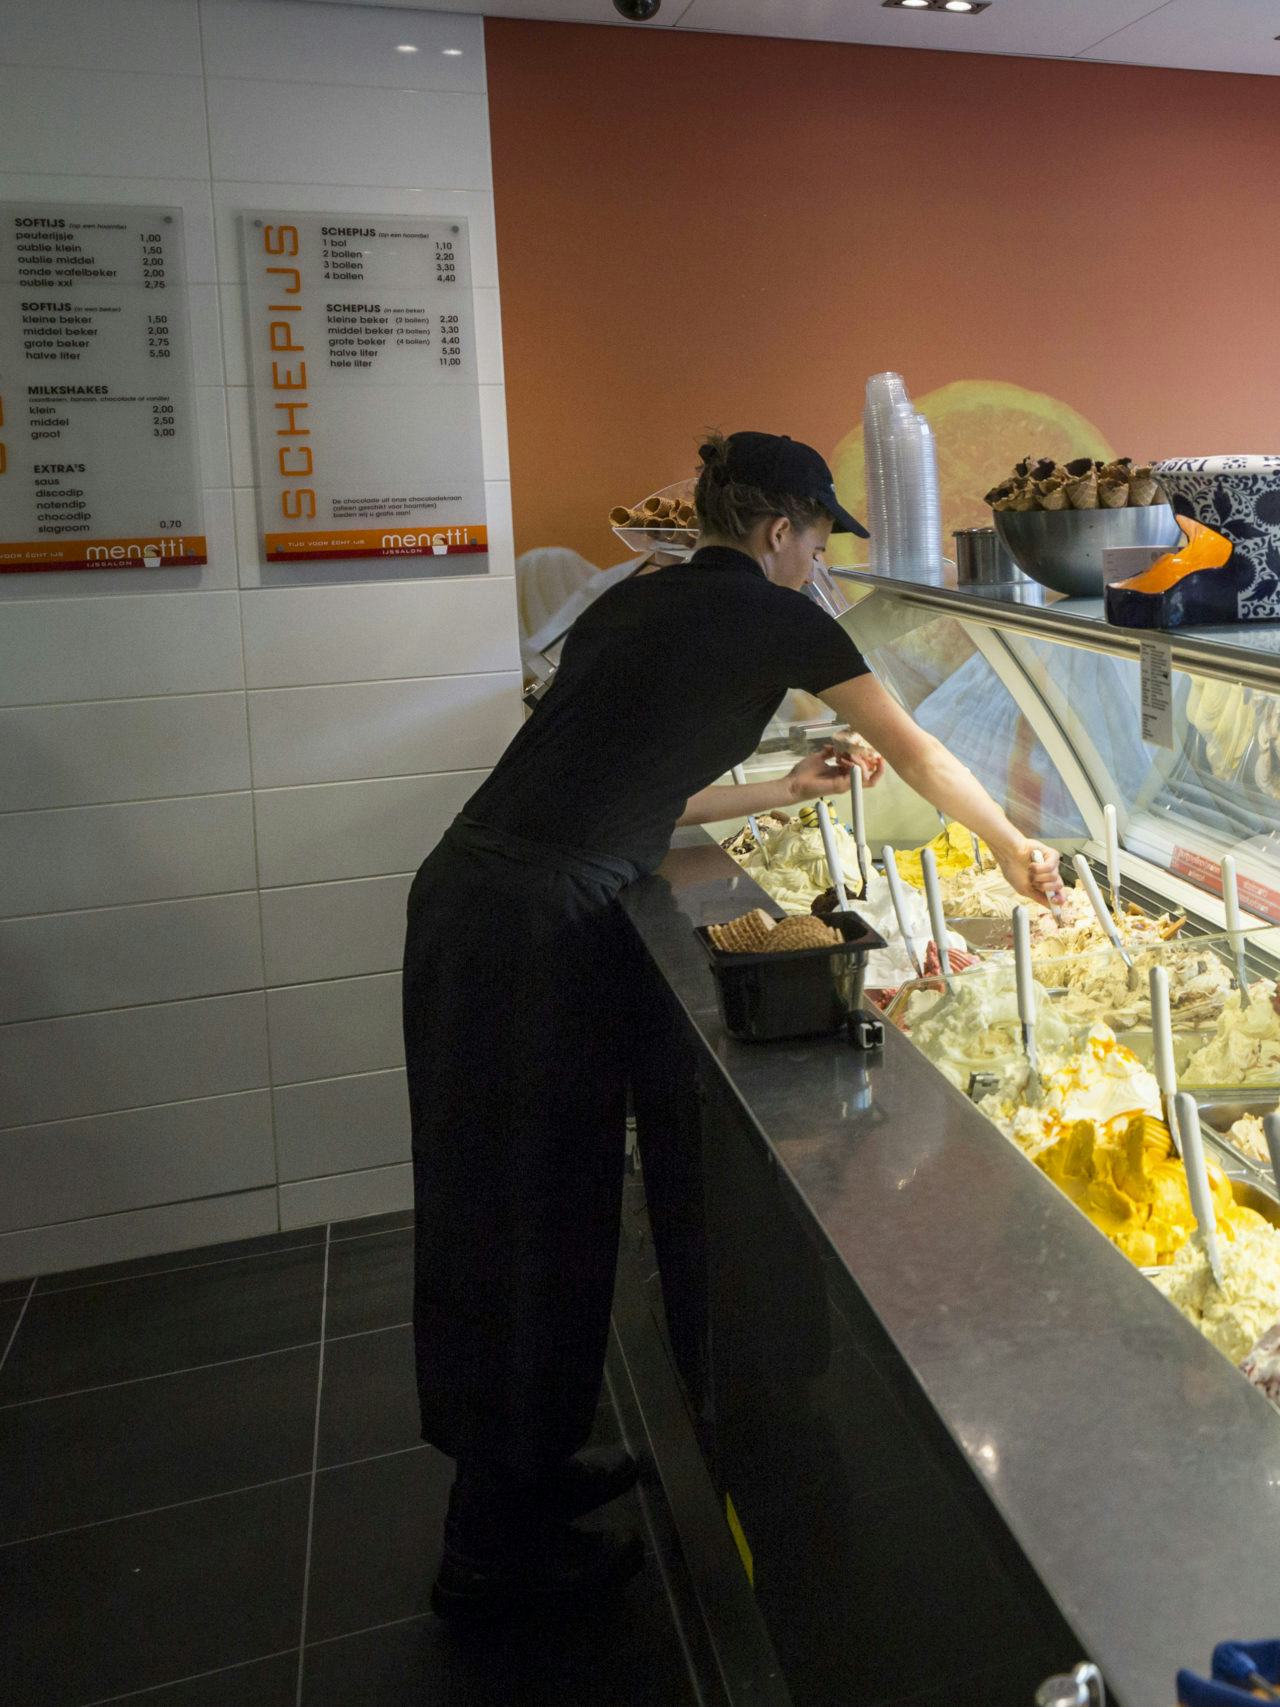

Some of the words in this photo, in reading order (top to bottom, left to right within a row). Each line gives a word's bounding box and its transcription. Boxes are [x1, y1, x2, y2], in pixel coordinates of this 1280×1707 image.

[15, 218, 65, 227] SOFTIJS
[321, 227, 376, 237] SCHEPIJS
[16, 232, 74, 241] peuterijsje
[140, 234, 161, 243] 1,00
[331, 239, 346, 247] bol
[436, 242, 452, 250] 1,10
[56, 244, 81, 252] klein
[143, 246, 162, 255] 1,50
[56, 256, 94, 264] middel
[436, 253, 454, 261] 2,20
[143, 258, 163, 266] 2,00
[332, 261, 363, 269] bollen
[436, 264, 455, 272] 3,30
[55, 269, 117, 277] wafelbeker
[144, 269, 164, 279] 2,00
[333, 272, 363, 280] bollen
[437, 274, 455, 282] 4,40
[19, 279, 55, 287] oublie
[58, 279, 72, 287] xxl
[144, 280, 166, 289] 2,75
[21, 303, 72, 311] SOFTIJS
[326, 304, 381, 312] SCHEPIJS
[60, 316, 92, 324] beker
[148, 315, 167, 324] 1,50
[440, 315, 458, 323] 2,20
[66, 328, 97, 336] beker
[148, 327, 168, 336] 2,00
[441, 326, 459, 334] 3,30
[24, 340, 54, 349] grote
[149, 338, 169, 346] 2,75
[329, 339, 354, 347] grote
[149, 349, 170, 359] 5,50
[360, 349, 378, 357] liter
[442, 347, 460, 355] 5,50
[26, 352, 57, 360] halve
[60, 352, 80, 360] liter
[330, 360, 351, 368] hele
[354, 360, 372, 368] liter
[440, 358, 461, 367] 11,00
[264, 224, 316, 520] SCHEPIJS
[28, 386, 108, 395] MILKSHAKES
[153, 405, 173, 413] 2,00
[30, 418, 69, 426] middel
[153, 417, 174, 425] 2,50
[31, 430, 60, 440] groot
[154, 428, 175, 438] 3,00
[34, 464, 86, 473] EXTRA'S
[36, 489, 84, 497] discodip
[37, 500, 86, 509] notendip
[37, 512, 91, 521] chocodip
[160, 520, 182, 529] 0,70
[38, 525, 90, 534] slagroom
